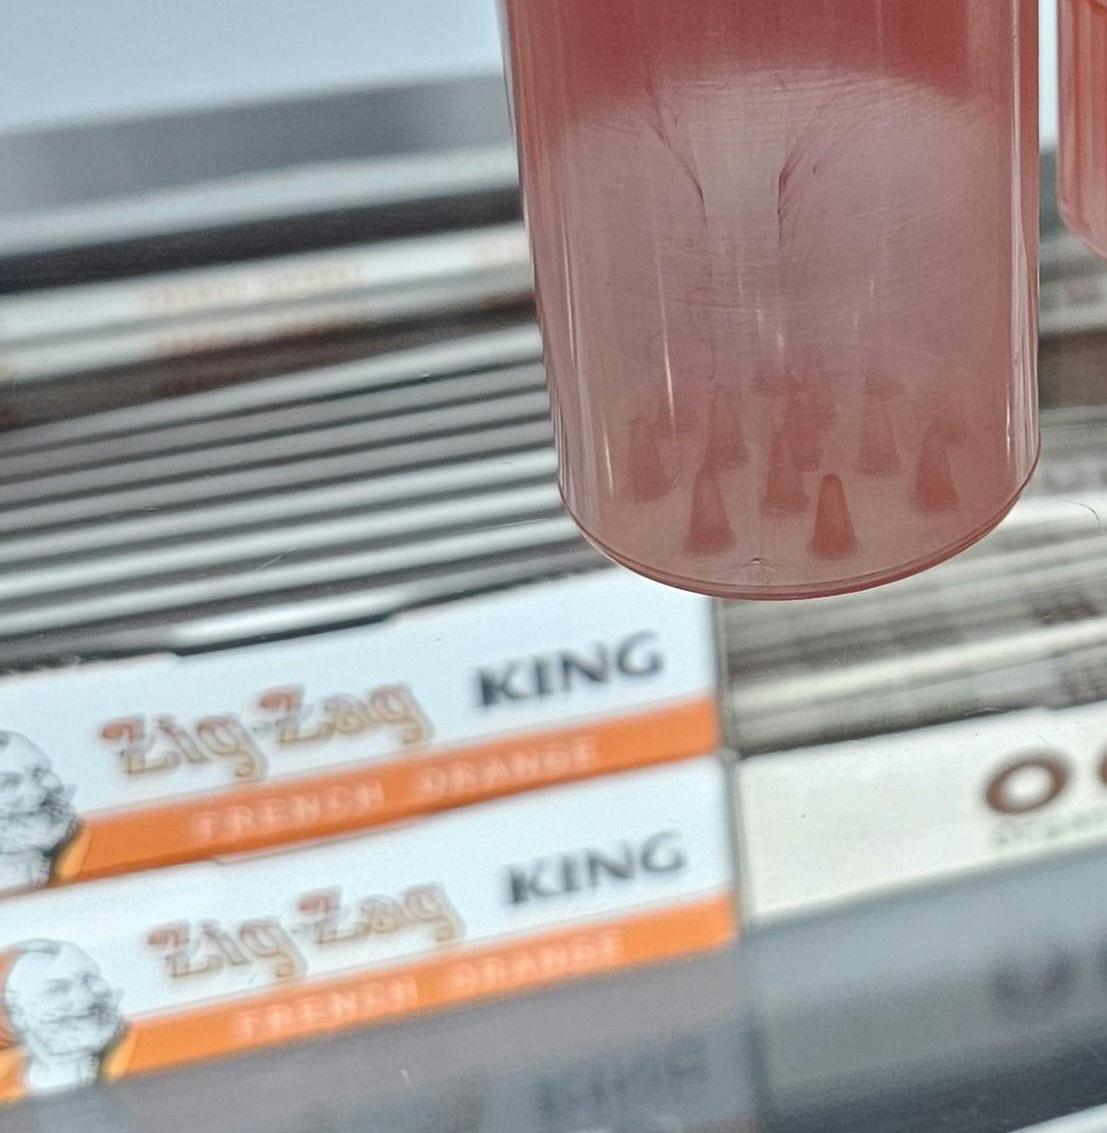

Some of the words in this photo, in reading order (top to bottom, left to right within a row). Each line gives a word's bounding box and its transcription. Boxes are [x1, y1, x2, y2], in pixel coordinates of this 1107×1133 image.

[99, 682, 436, 784] Zig-Zag
[476, 631, 666, 710] KING
[191, 779, 388, 846] FRENCH
[417, 736, 599, 799] ORANGE
[146, 882, 467, 984] Zig-Zag
[504, 831, 688, 908] KING
[230, 975, 421, 1043] FRENCH
[447, 931, 626, 991] ORANGE
